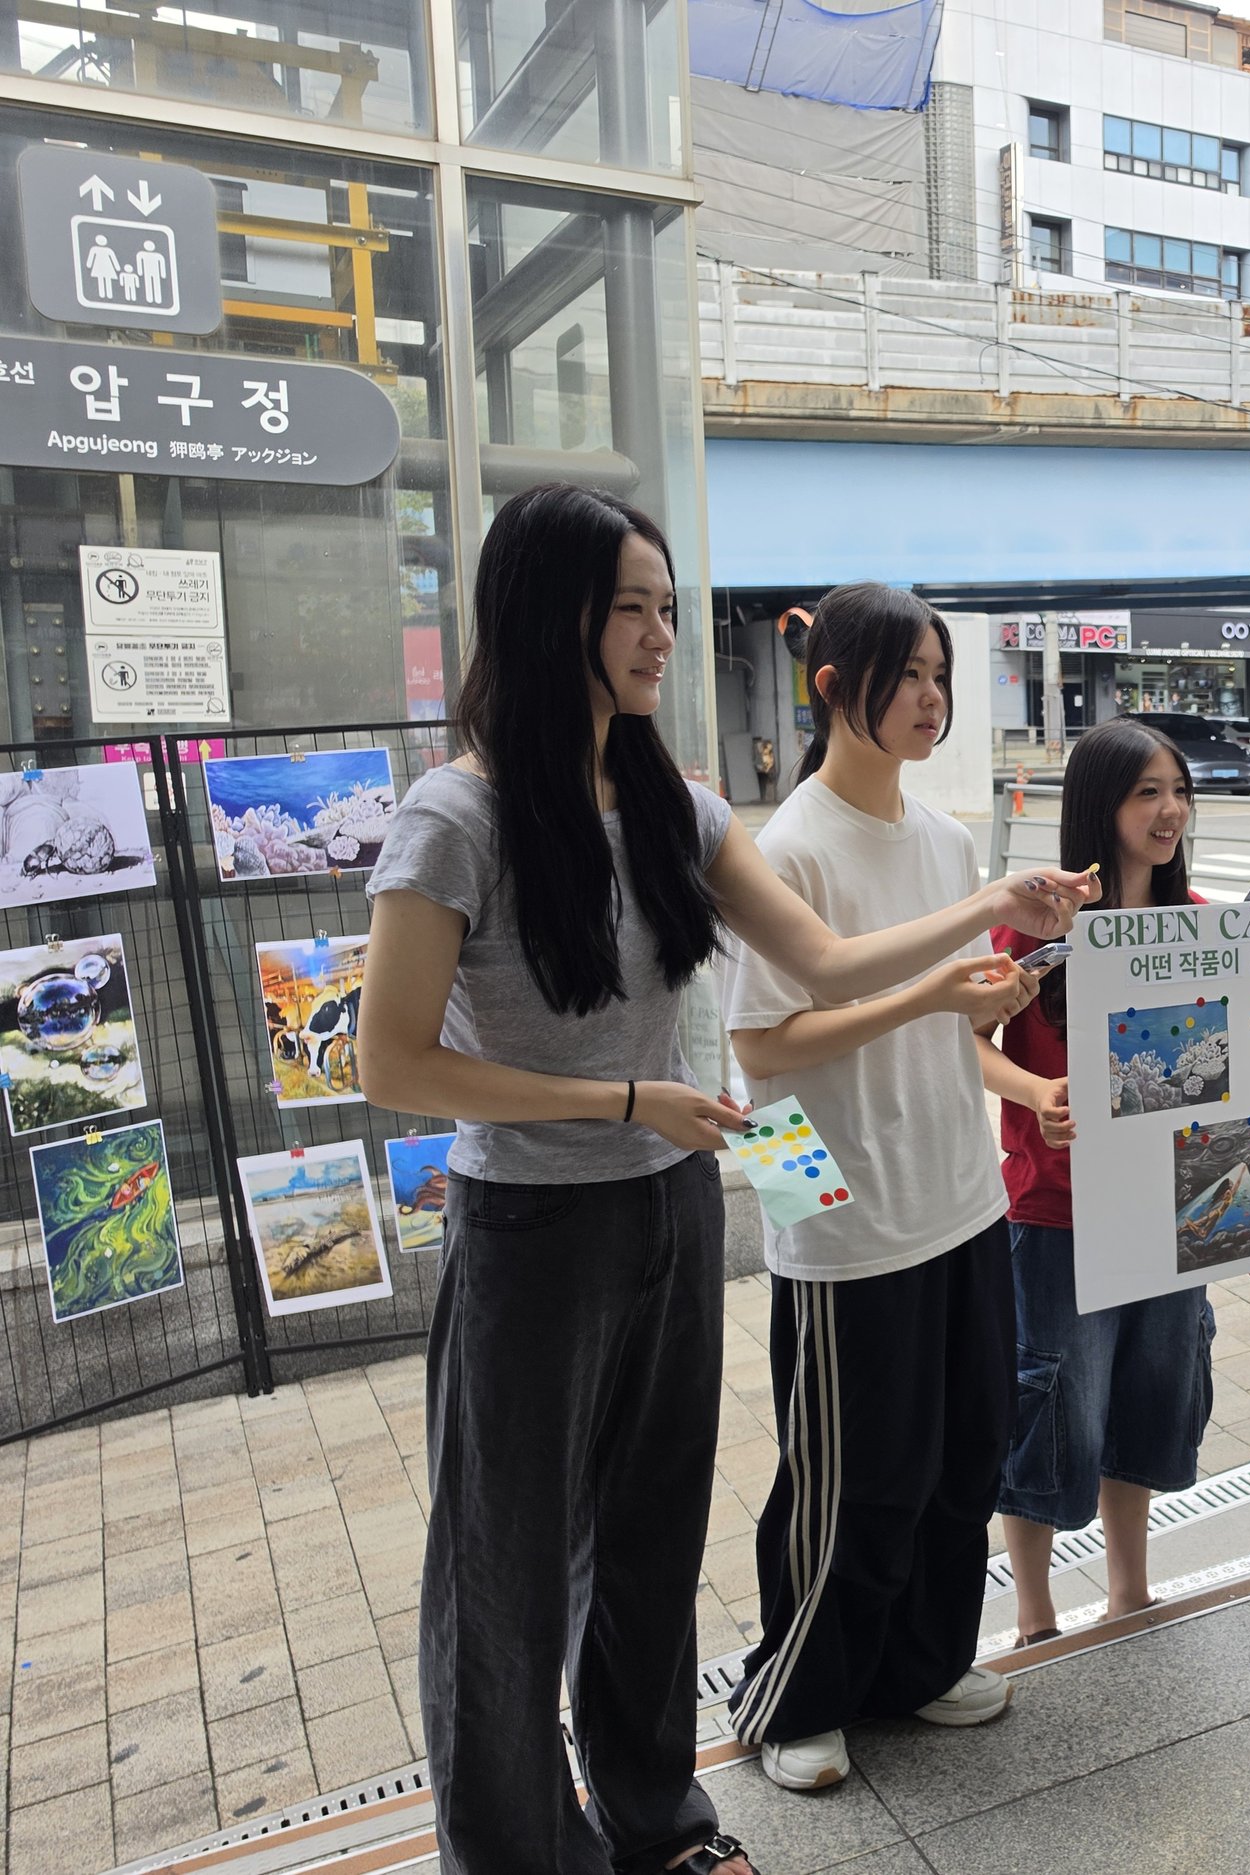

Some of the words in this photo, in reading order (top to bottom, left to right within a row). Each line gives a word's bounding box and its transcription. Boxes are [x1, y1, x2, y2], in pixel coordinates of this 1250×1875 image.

[70, 365, 290, 434] 압구정
[48, 430, 158, 458] Apgujeong
[231, 446, 318, 466] アックジョン
[1080, 625, 1117, 649] PC
[1088, 909, 1199, 949] GREEN
[1130, 953, 1173, 982] 어떤
[1178, 947, 1240, 978] 작품이
